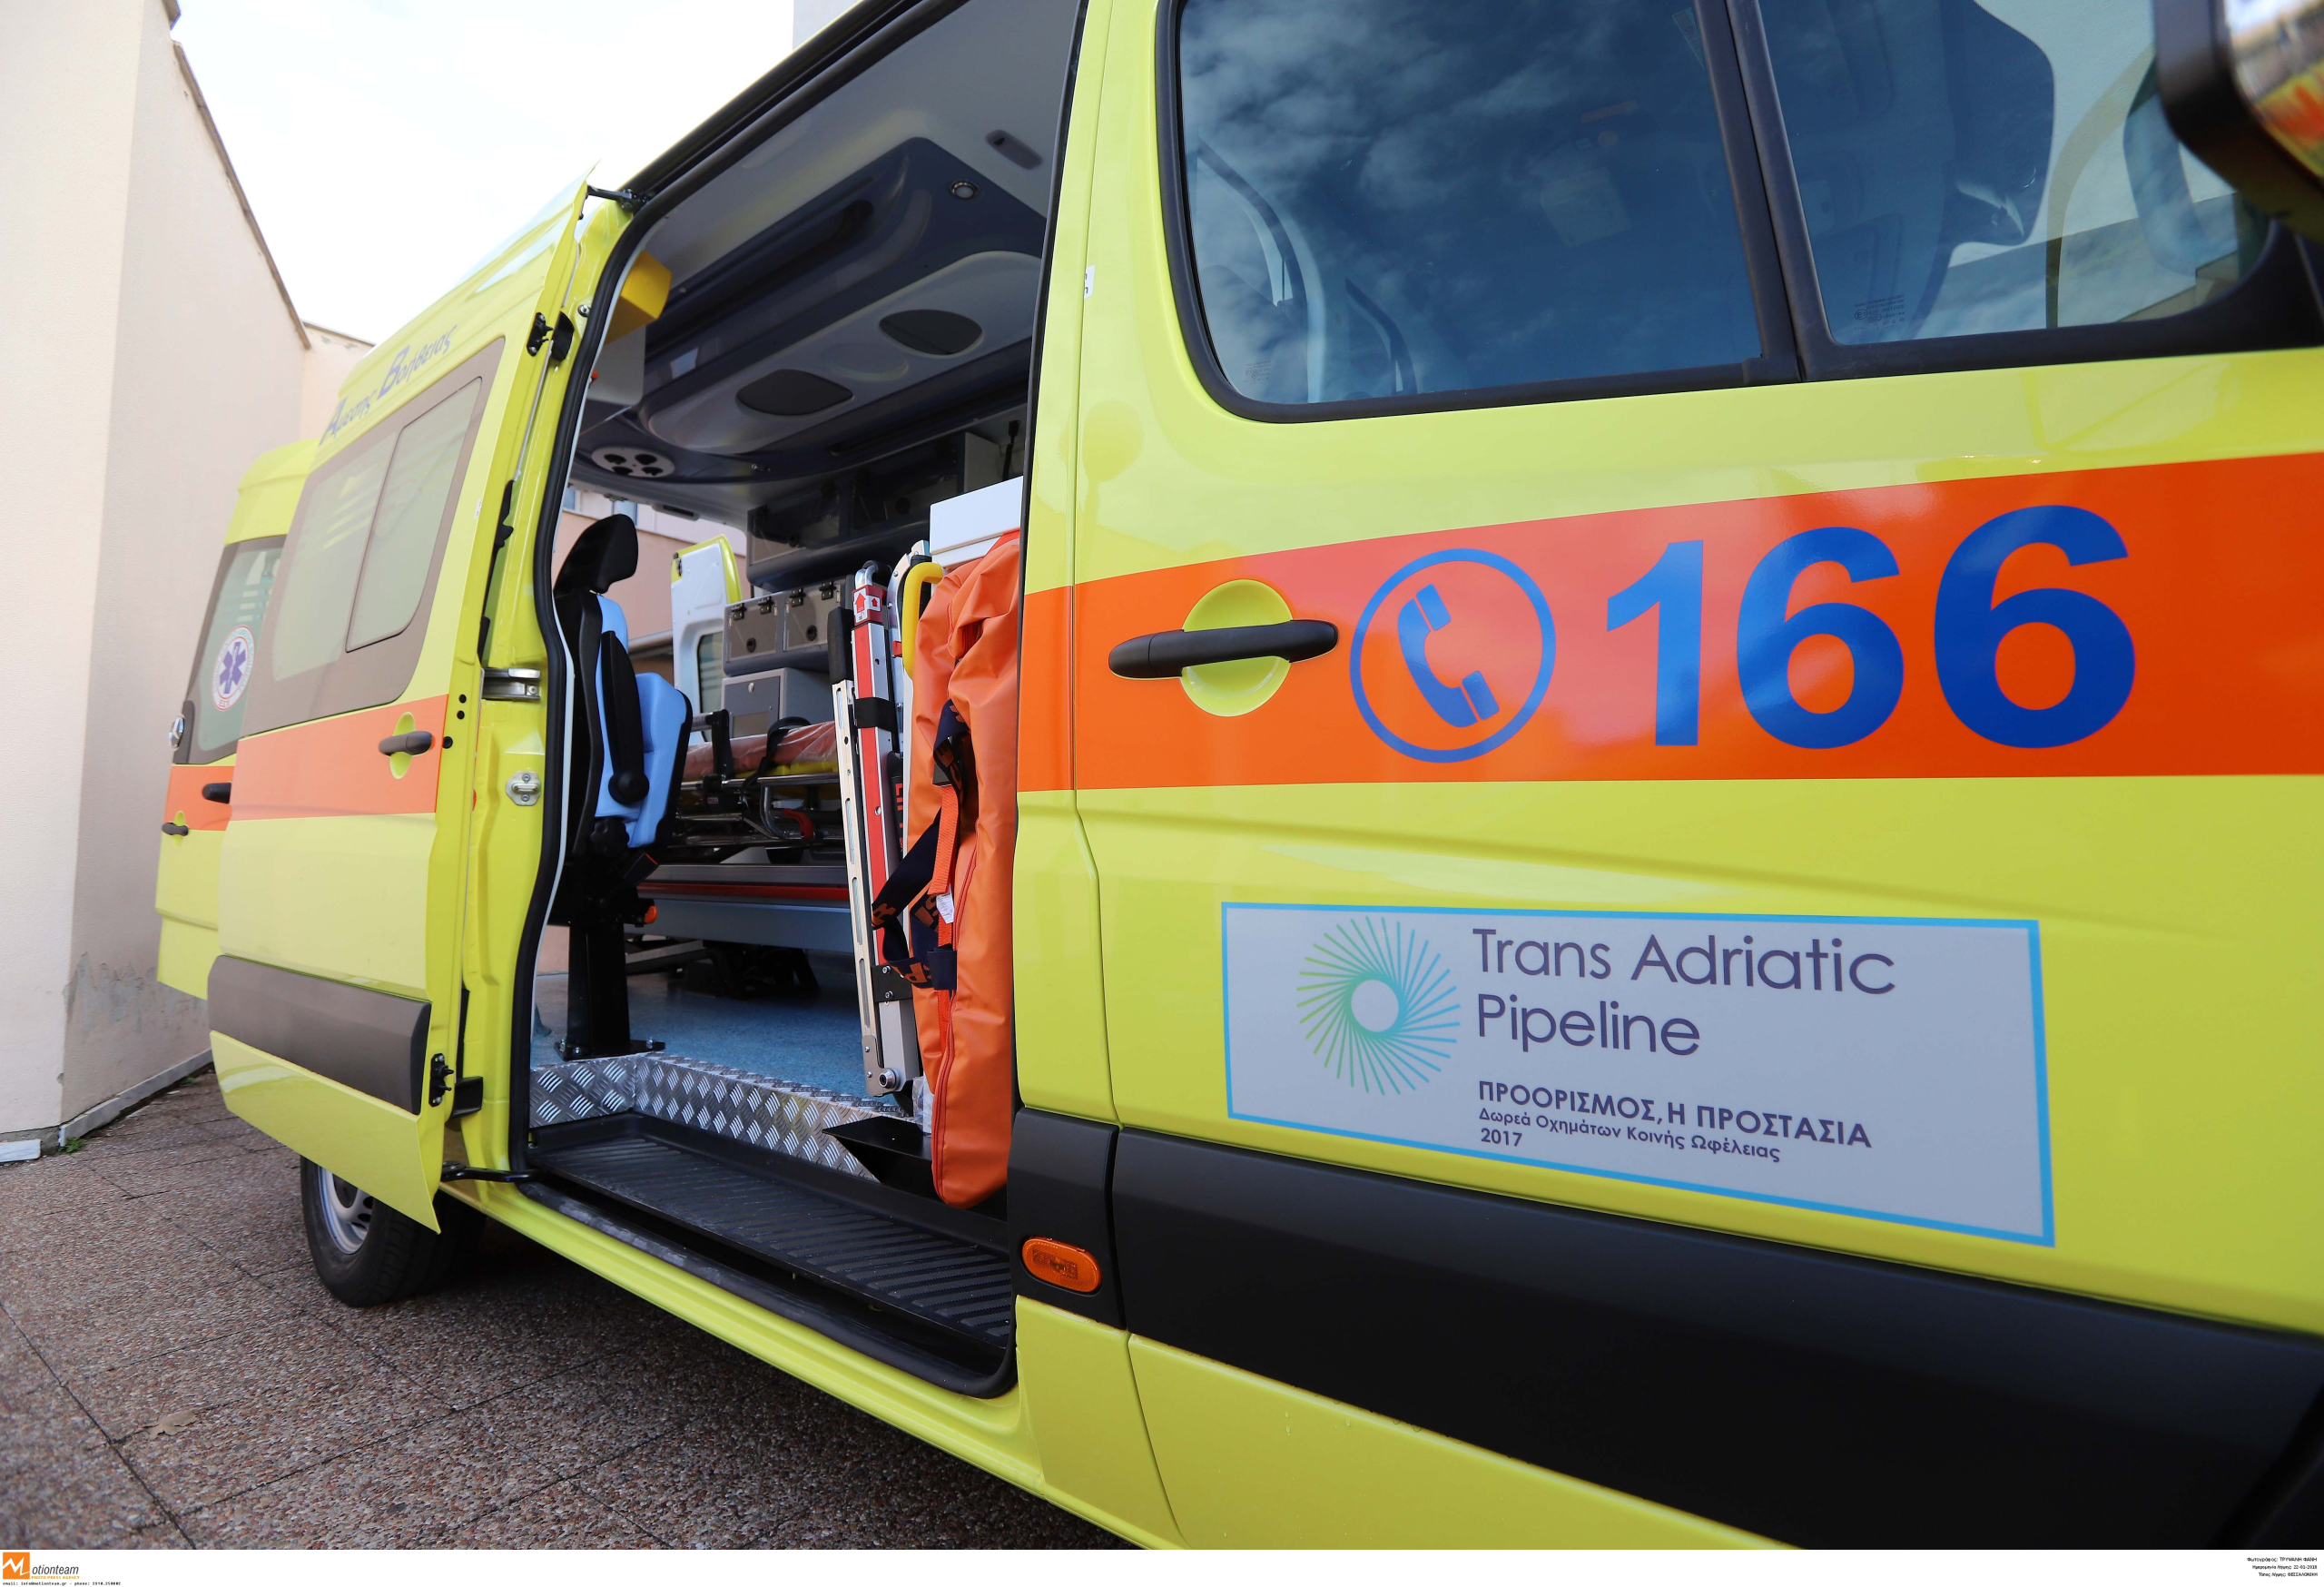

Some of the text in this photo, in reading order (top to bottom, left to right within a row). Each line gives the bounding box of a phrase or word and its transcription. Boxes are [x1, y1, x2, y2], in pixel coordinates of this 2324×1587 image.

[1607, 505, 2136, 749] 166
[1472, 928, 1896, 995] Trans Adriatic
[1478, 993, 1700, 1056] Pipeline
[1479, 1108, 1781, 1163] Δωρεά Οχημάτων Κοινής Ωφέλειας
[1481, 1128, 1523, 1148] 2017
[1697, 1105, 1872, 1148] ΠΡΟΣΤΑΣΙΑ
